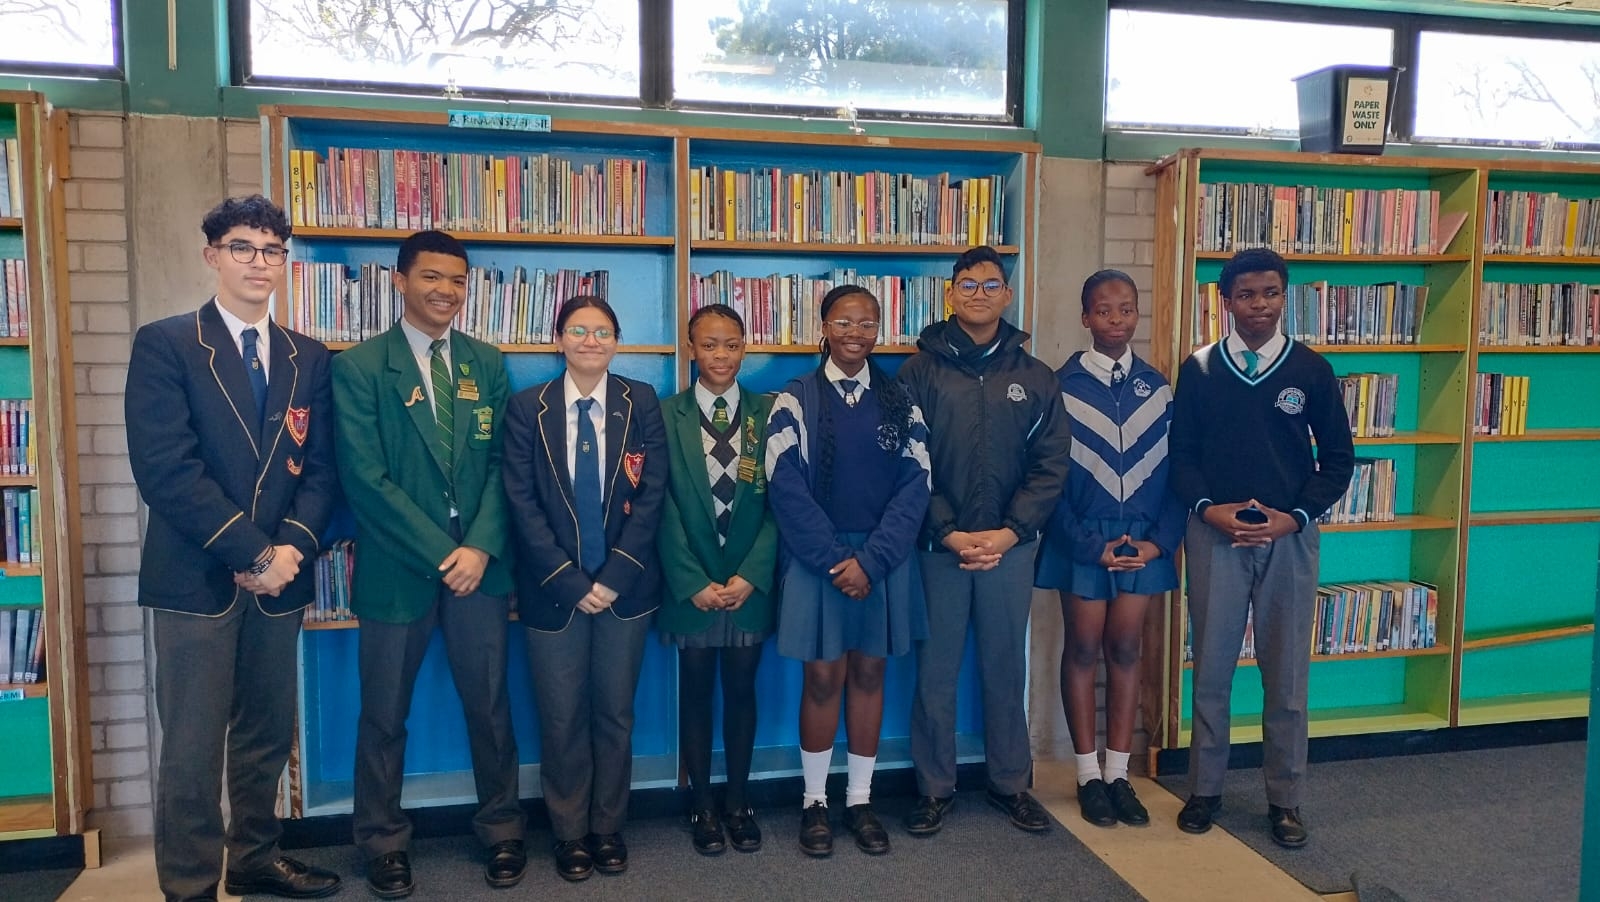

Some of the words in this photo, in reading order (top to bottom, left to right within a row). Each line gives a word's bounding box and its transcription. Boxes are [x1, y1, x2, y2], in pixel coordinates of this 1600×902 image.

[1354, 101, 1380, 109] PAPER
[1352, 111, 1380, 119] WASTE
[1354, 121, 1376, 129] ONLY
[306, 182, 313, 190] A
[794, 201, 801, 210] G
[1513, 399, 1518, 407] Y
